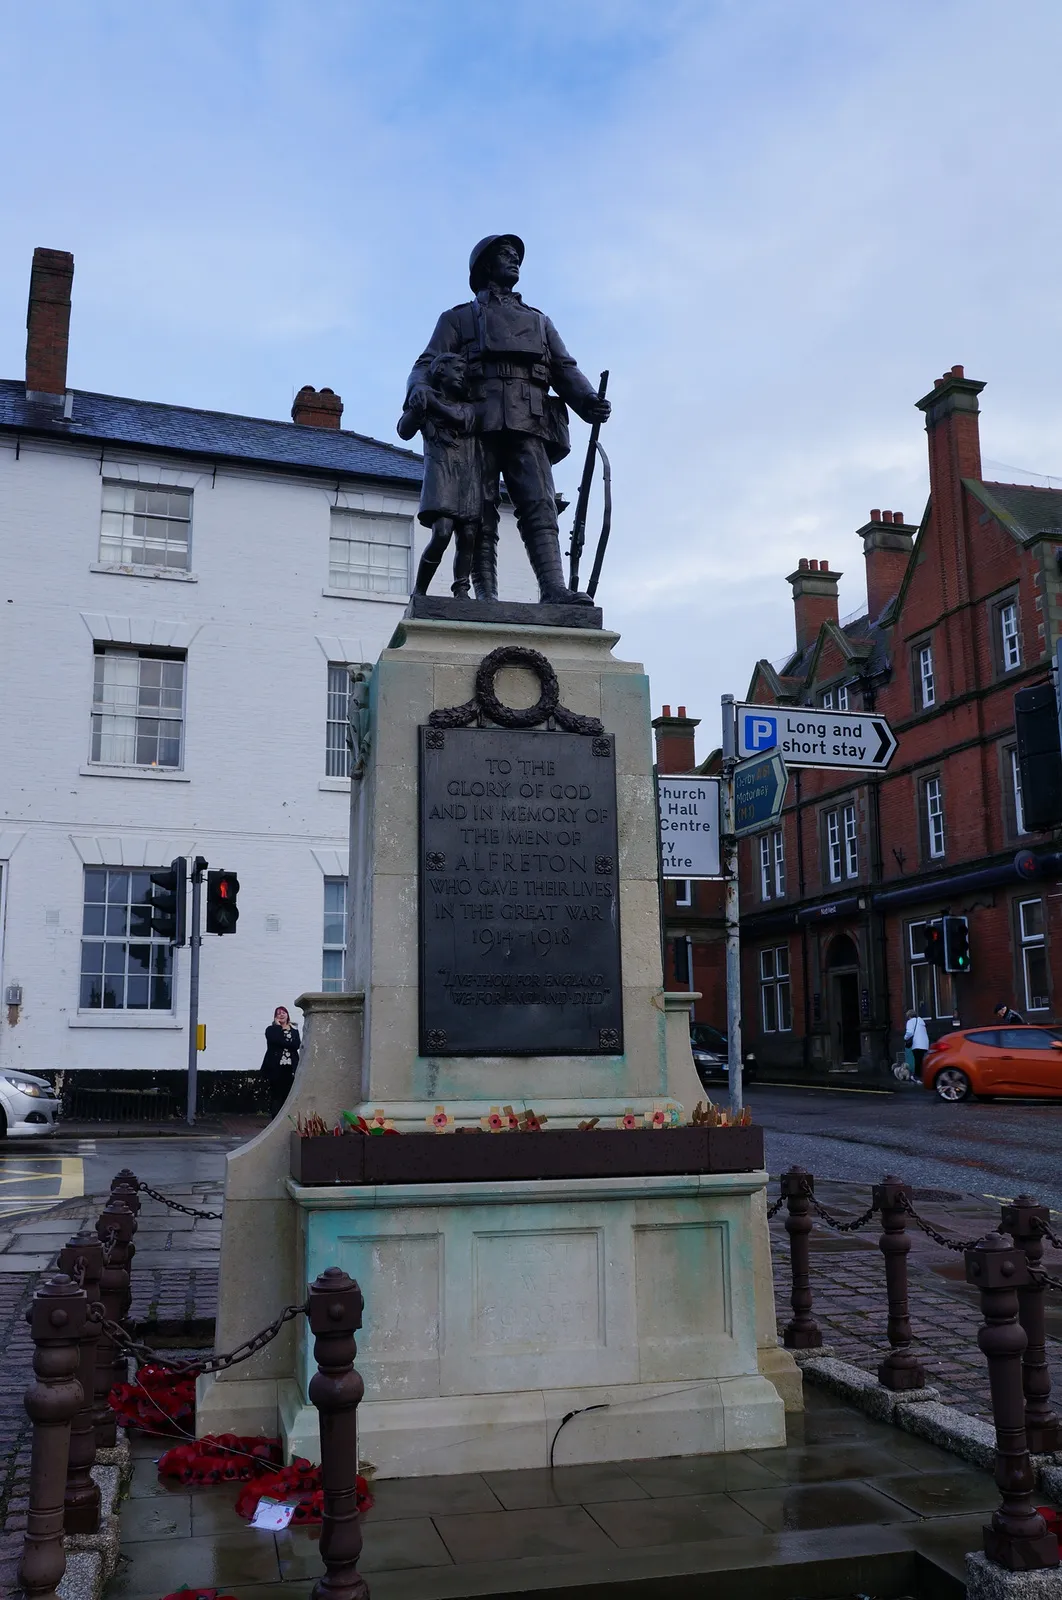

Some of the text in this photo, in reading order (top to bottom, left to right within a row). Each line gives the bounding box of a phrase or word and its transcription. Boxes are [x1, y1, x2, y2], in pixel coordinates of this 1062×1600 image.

[752, 719, 773, 748] P
[787, 718, 862, 738] Long and
[782, 738, 867, 760] short stay
[485, 759, 556, 776] TO THE
[447, 780, 592, 800] GLORY OF GOD
[736, 774, 755, 789] Derby
[736, 785, 769, 805] Motorway
[428, 804, 609, 824] AND IN MEMORY OF
[668, 803, 698, 815] Hall
[660, 818, 711, 832] Centre
[460, 828, 582, 846] THE MEN OF
[455, 852, 587, 873] ALFRETON
[428, 878, 613, 898] WHO GAVE THEIR LIVES
[434, 903, 604, 921] IN THE GREAT WAR
